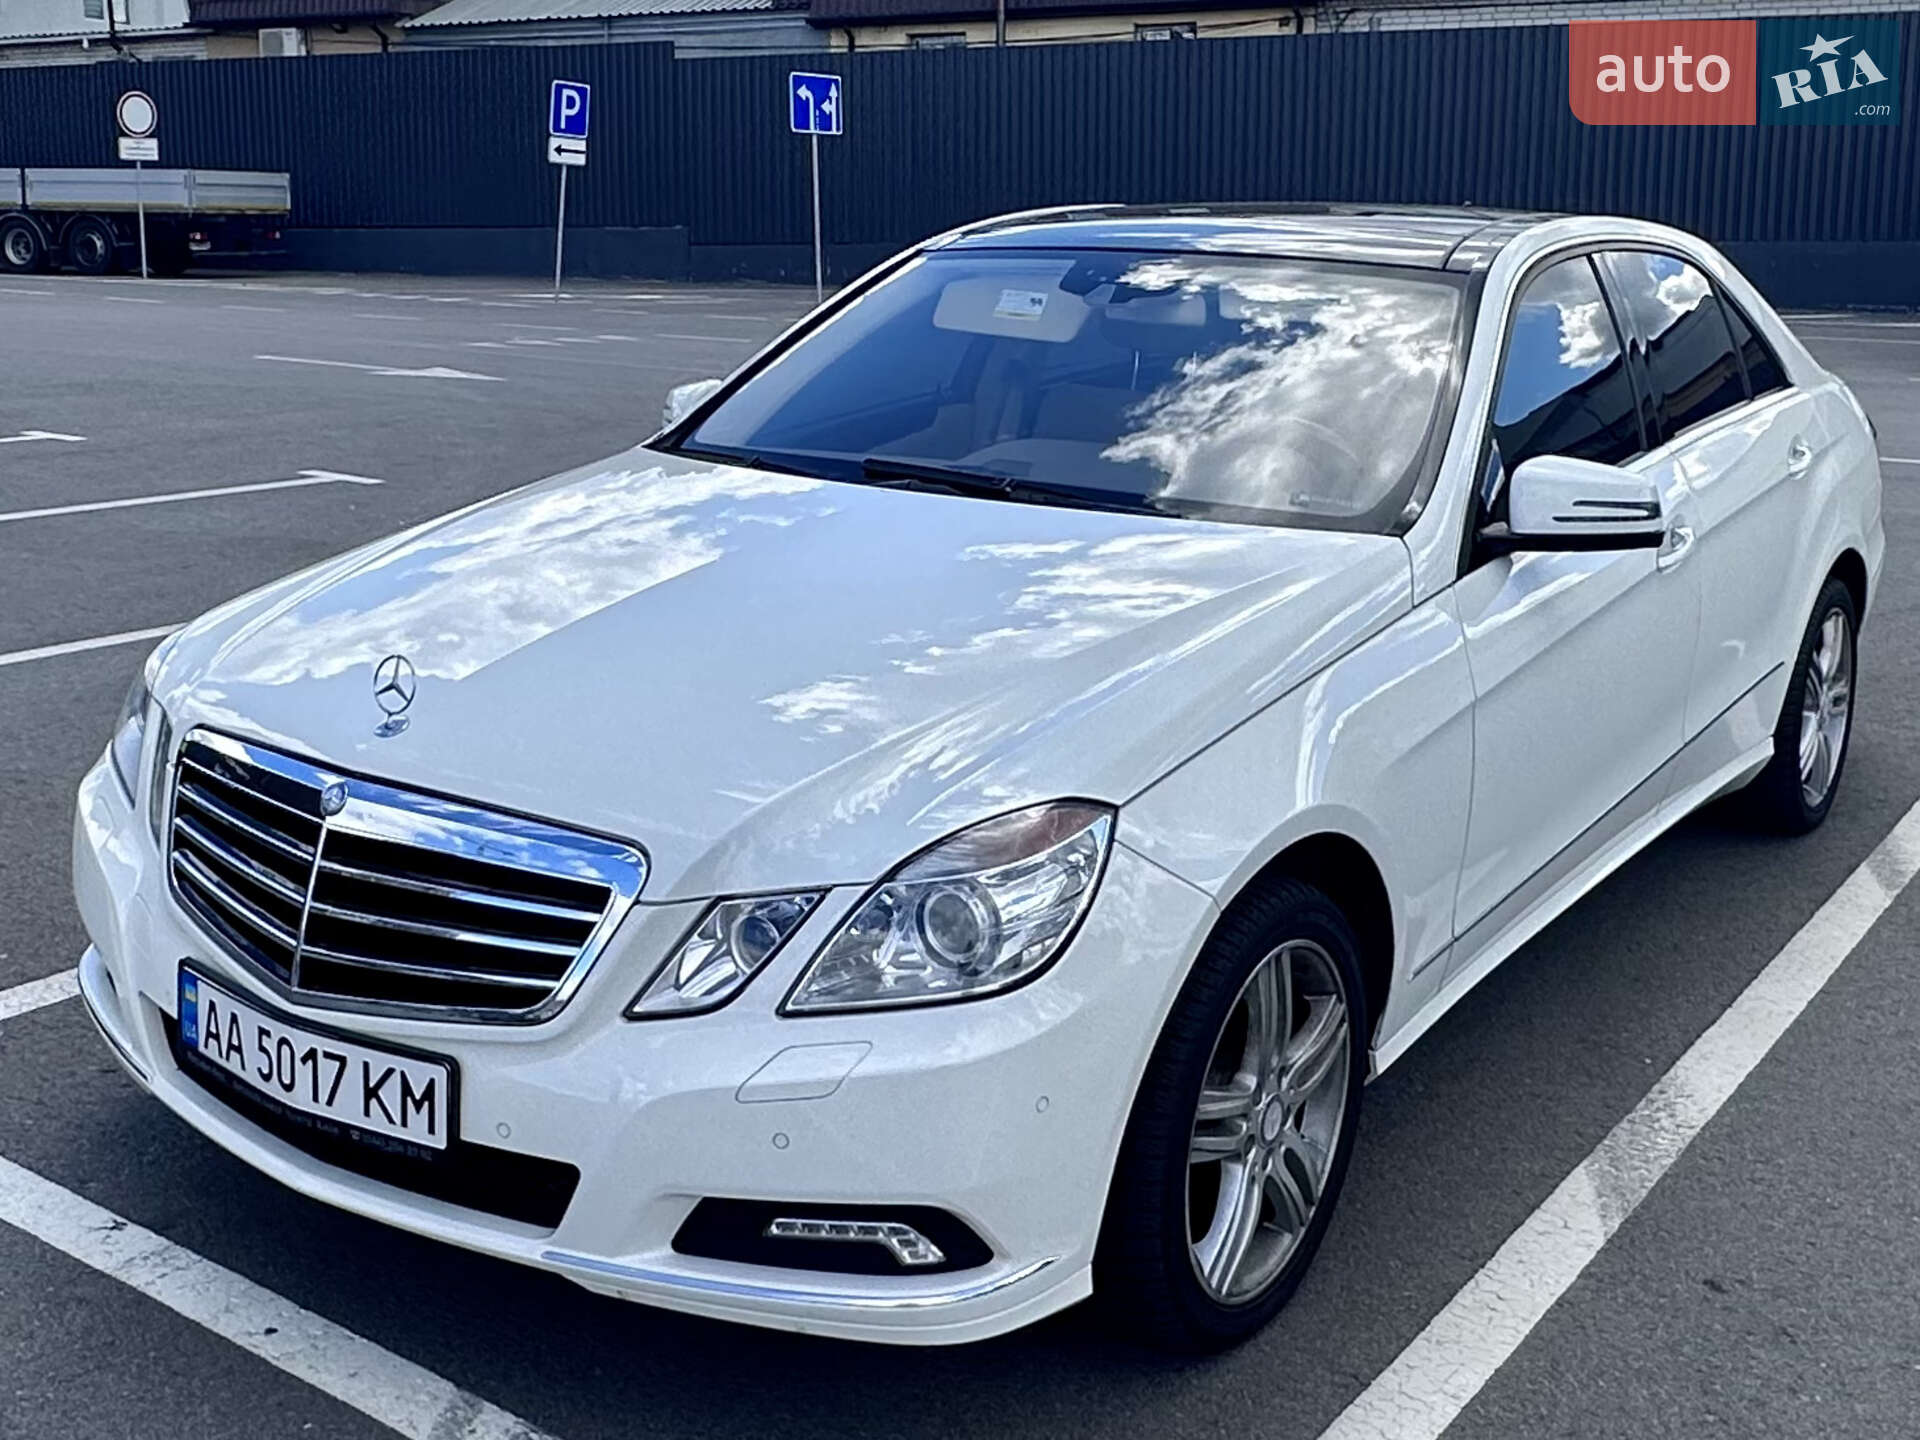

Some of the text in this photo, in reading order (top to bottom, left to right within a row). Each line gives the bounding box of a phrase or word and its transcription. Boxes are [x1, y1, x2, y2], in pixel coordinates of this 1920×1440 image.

[561, 88, 580, 129] P
[204, 999, 246, 1071] AA
[257, 1025, 347, 1107] 5017
[362, 1060, 436, 1136] KM
